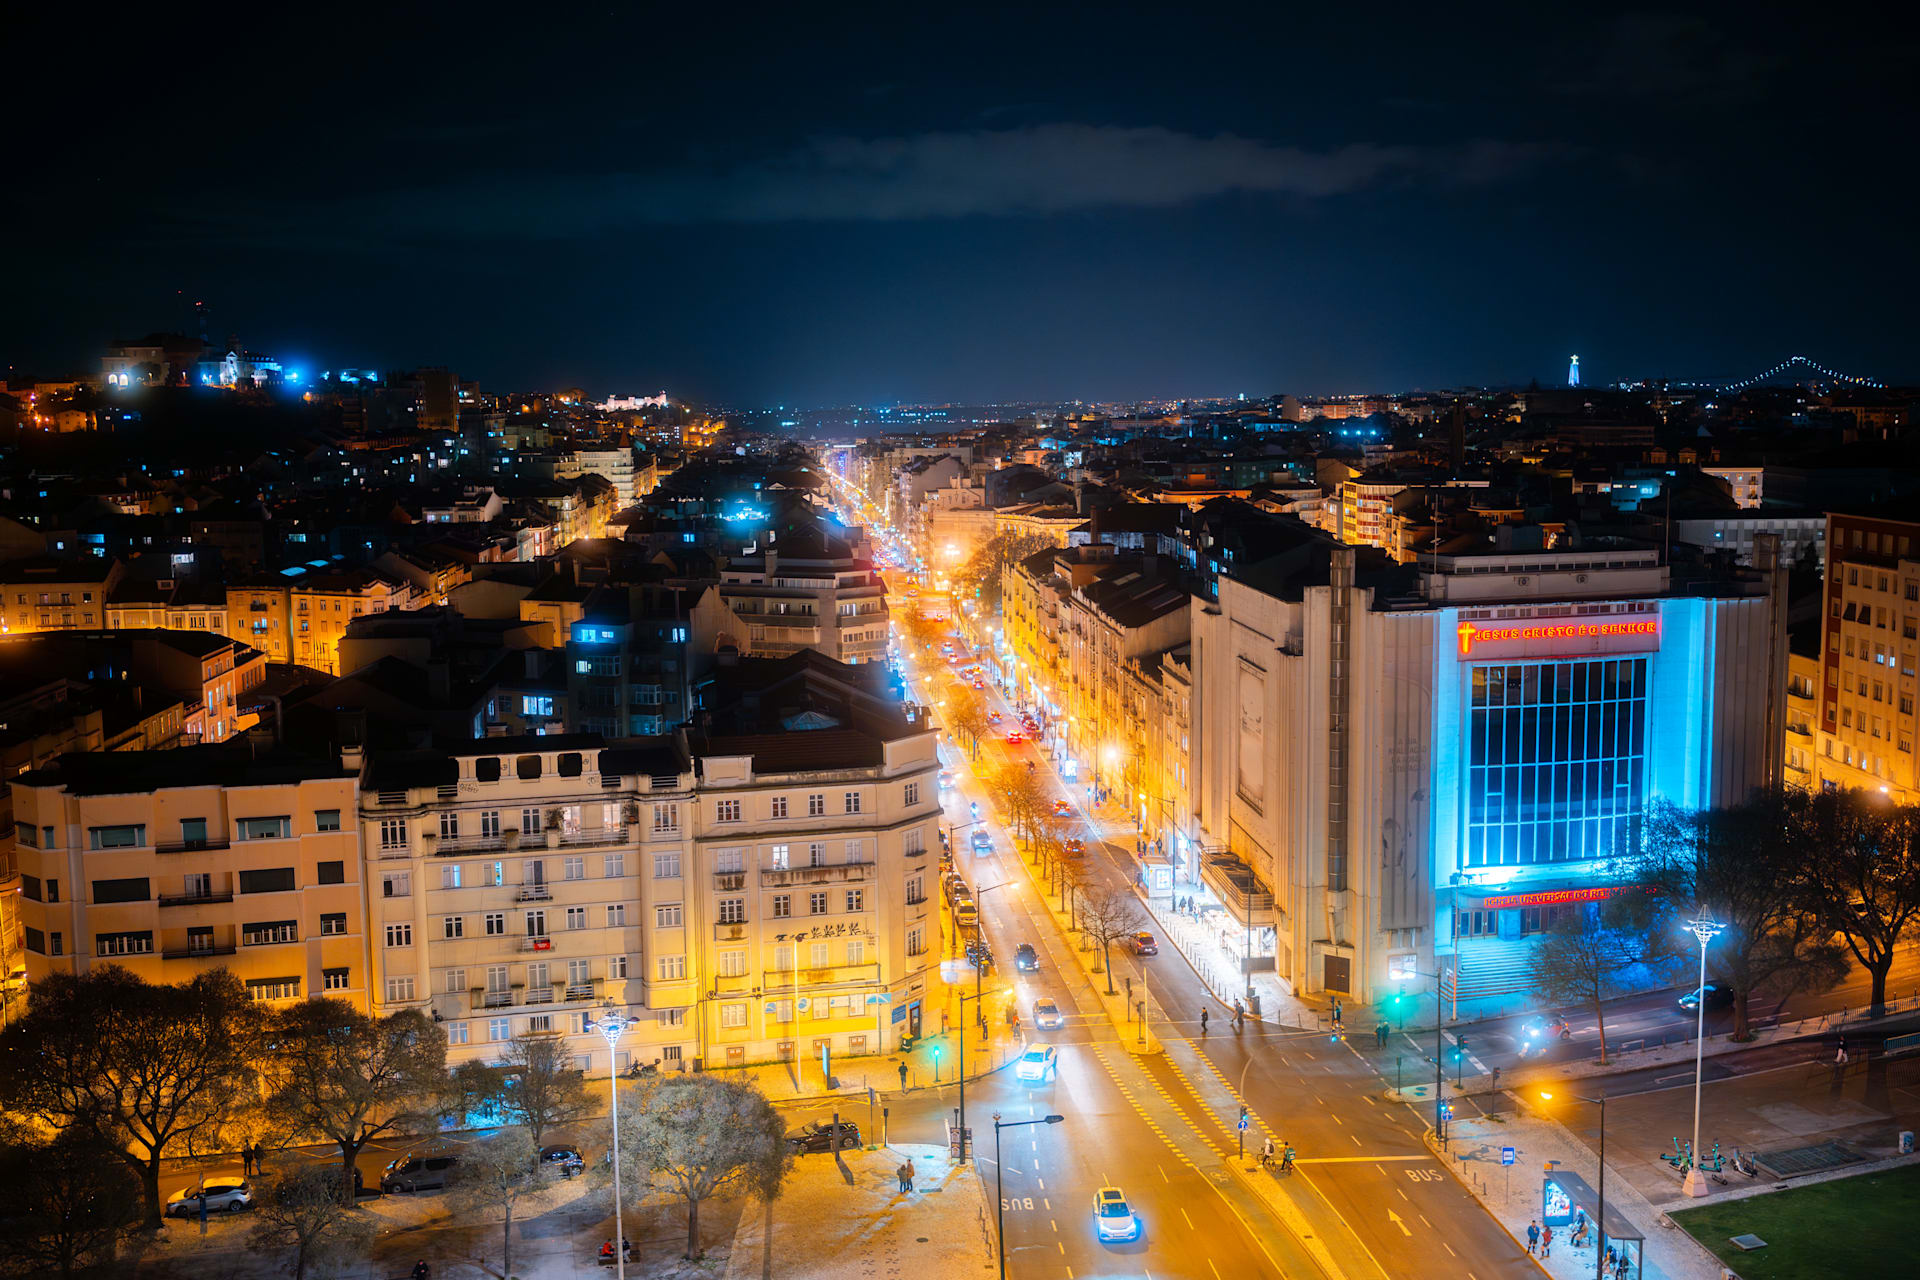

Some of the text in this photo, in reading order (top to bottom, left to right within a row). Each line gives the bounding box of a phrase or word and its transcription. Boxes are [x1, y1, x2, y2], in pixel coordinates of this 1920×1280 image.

[1475, 628, 1520, 641] JESUS
[1522, 625, 1575, 639] CRISTO
[1588, 623, 1599, 635] O
[1601, 621, 1657, 634] SENHOR
[1520, 890, 1571, 905] UNIVERSAL
[1404, 1169, 1443, 1182] BUS
[1001, 1197, 1034, 1211] BUS
